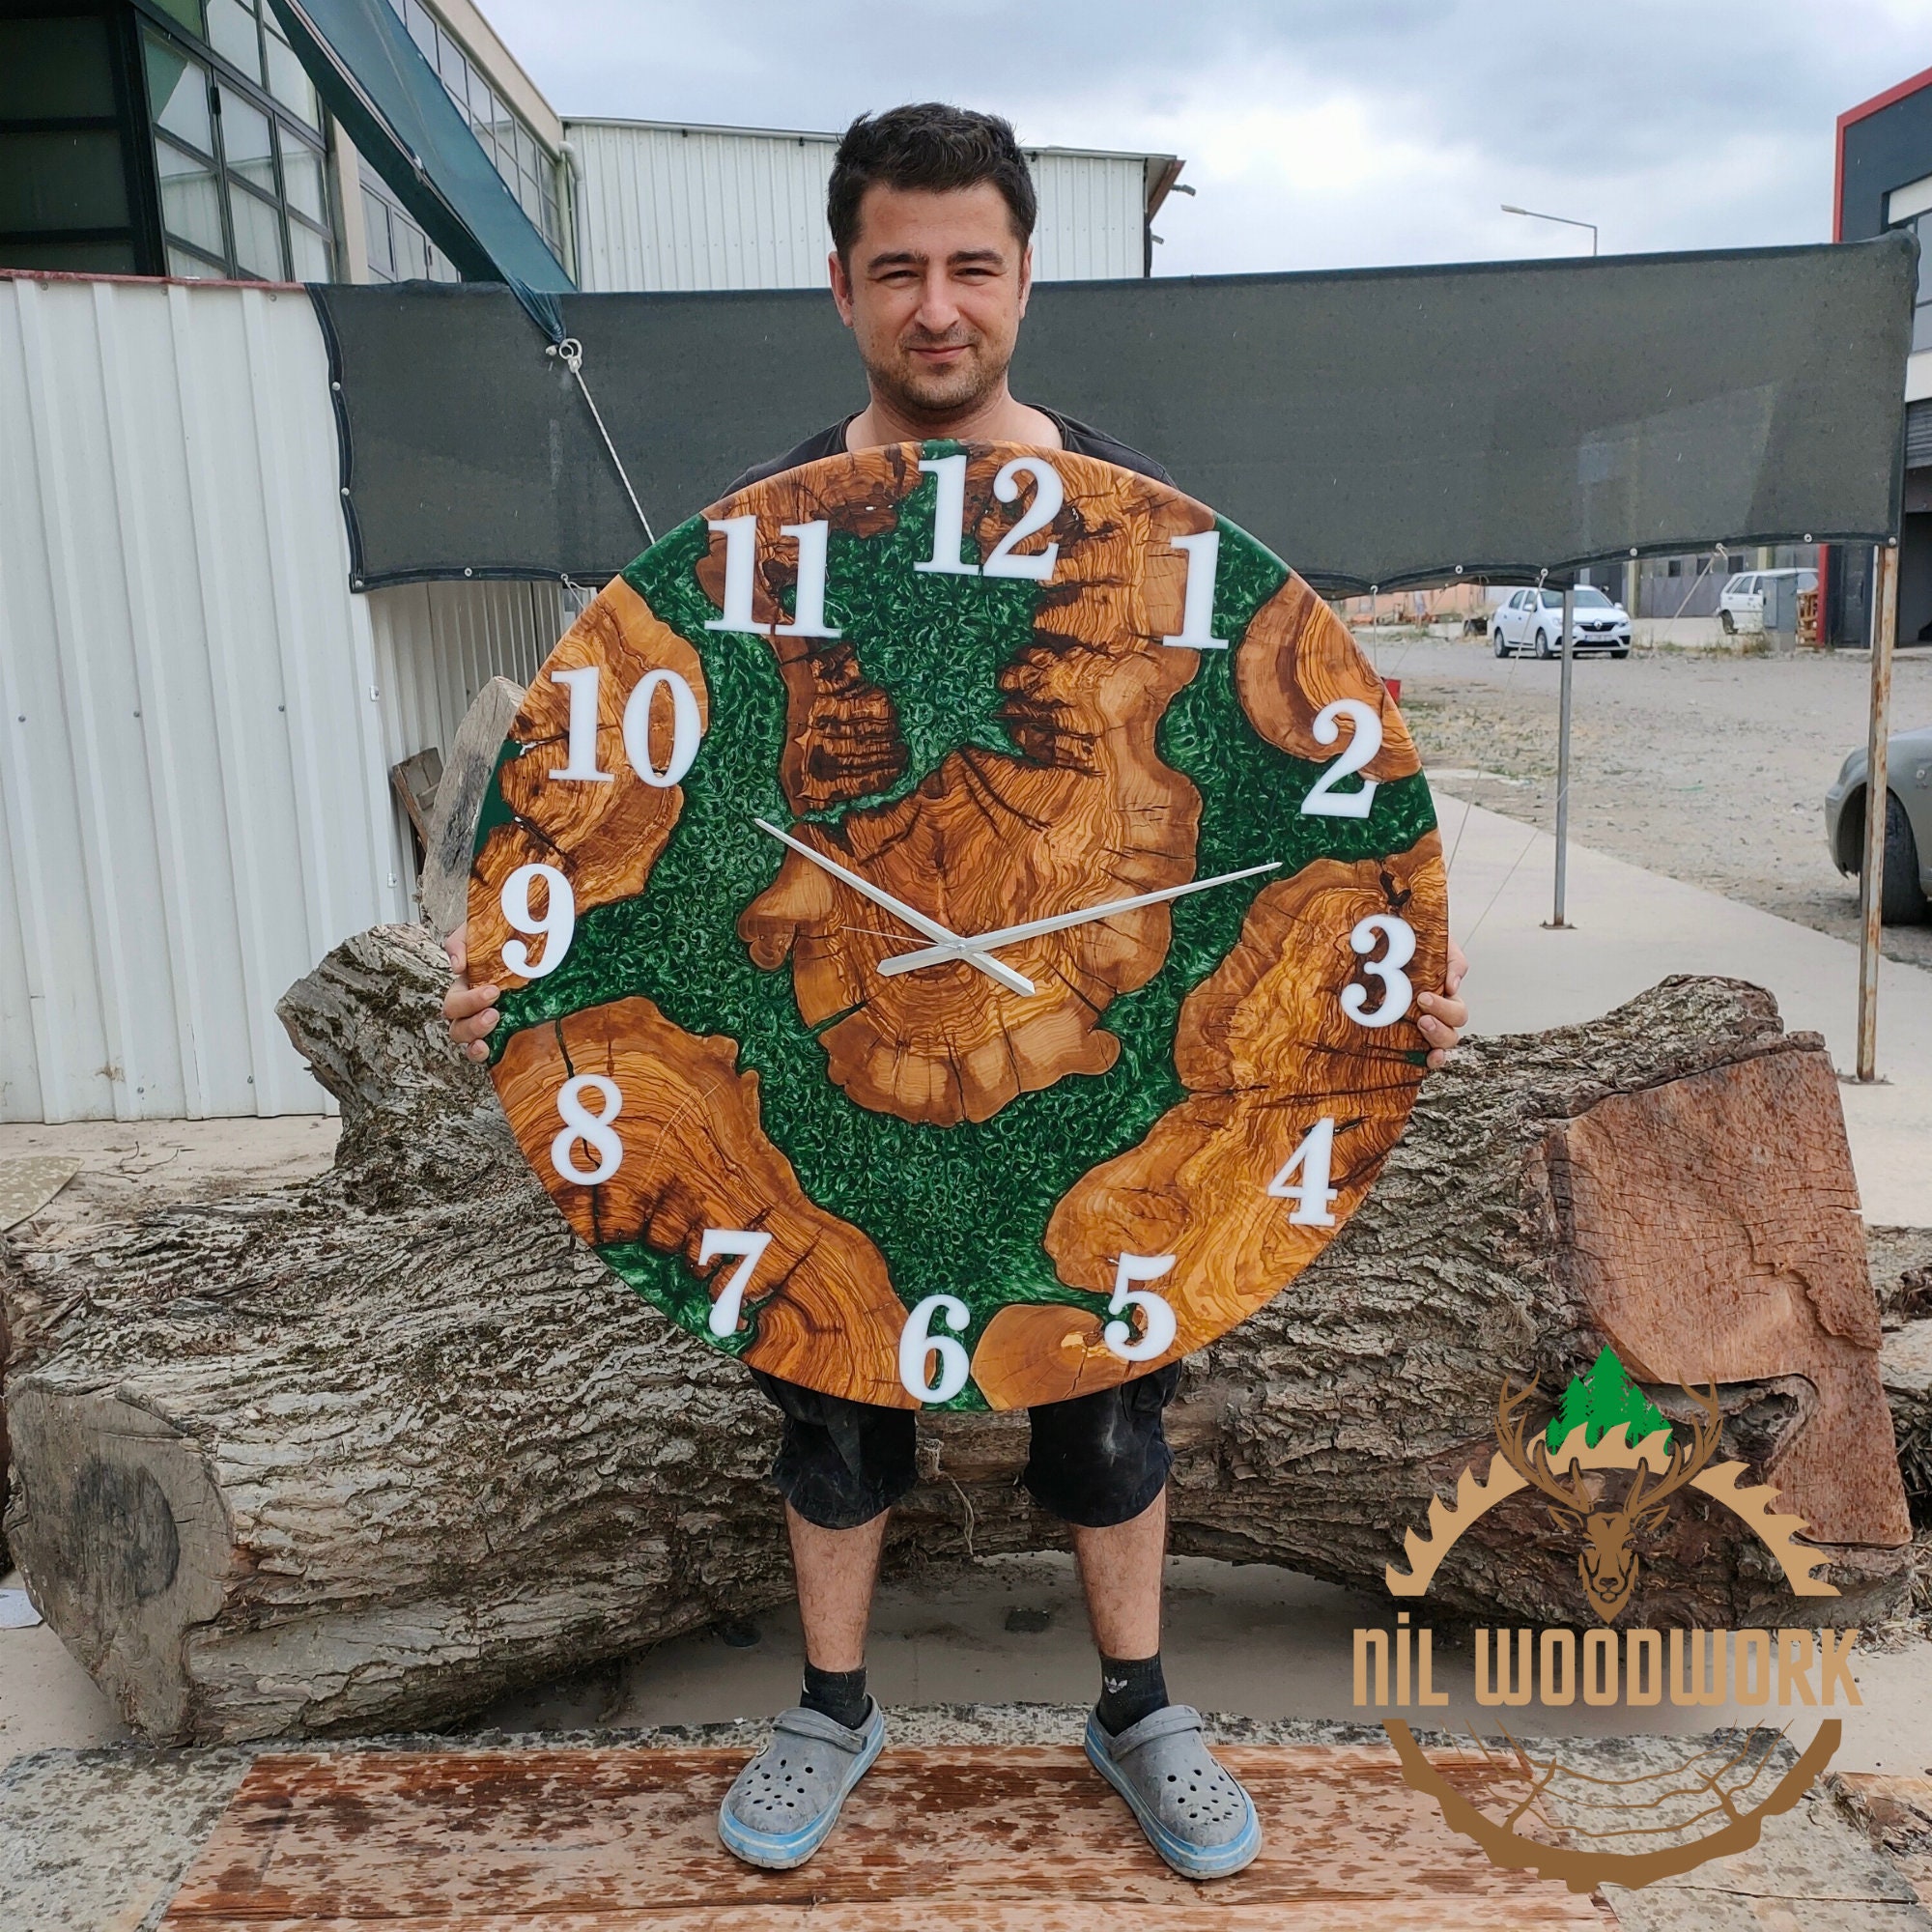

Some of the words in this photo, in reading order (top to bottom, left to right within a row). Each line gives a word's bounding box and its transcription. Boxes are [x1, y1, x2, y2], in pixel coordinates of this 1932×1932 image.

[916, 455, 1063, 582] 12
[705, 515, 841, 637] 11
[1163, 531, 1228, 649] 1
[550, 667, 703, 787] 10
[1301, 699, 1382, 817] 2
[501, 864, 575, 979] 9
[1341, 915, 1415, 1027] 3
[552, 1074, 622, 1184] 8
[1268, 1118, 1337, 1226] 4
[698, 1230, 772, 1337] 7
[1104, 1253, 1176, 1361] 5
[899, 1294, 970, 1403] 6
